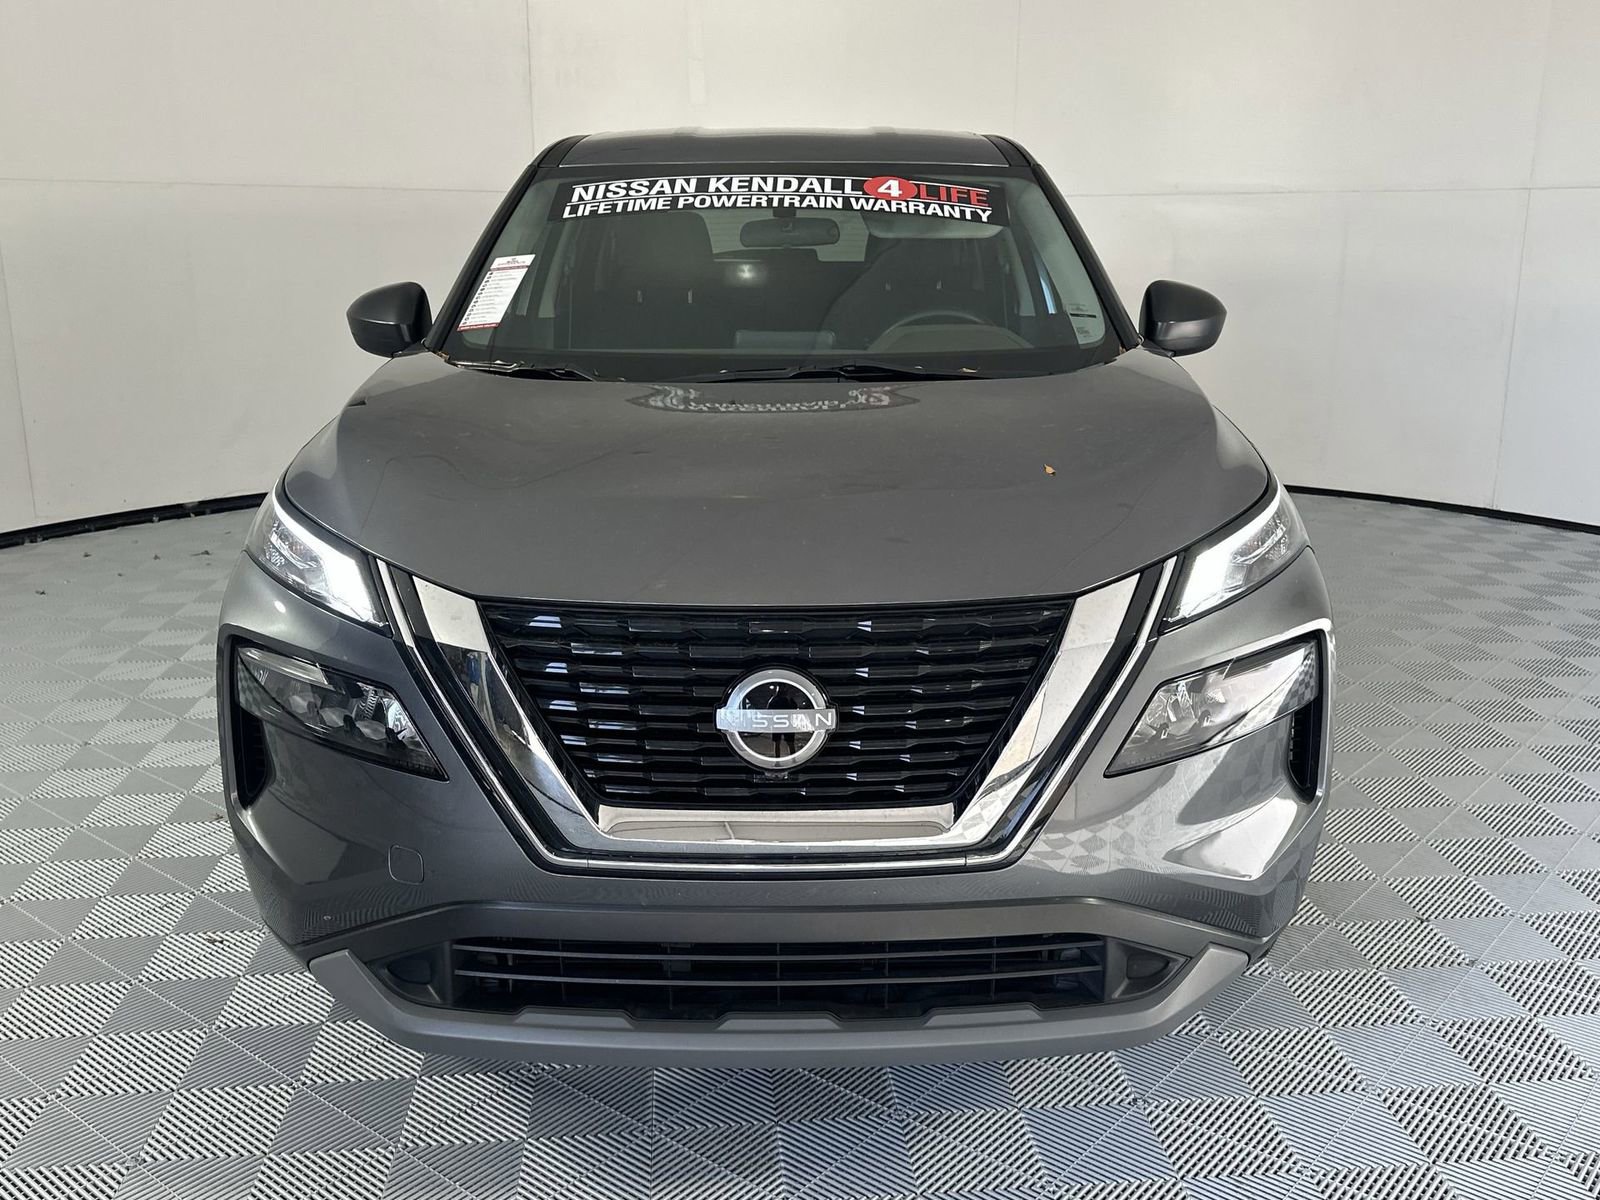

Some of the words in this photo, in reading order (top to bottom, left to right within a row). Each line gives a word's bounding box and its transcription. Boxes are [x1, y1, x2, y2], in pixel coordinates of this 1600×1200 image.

[571, 177, 697, 203] NISSAN
[707, 176, 863, 194] KENDALL
[877, 179, 903, 198] 4
[919, 184, 989, 207] LIFE
[562, 196, 673, 219] LIFETIME
[677, 194, 843, 210] POWERTRAIN
[849, 197, 993, 223] WARRANTY
[719, 711, 833, 730] NISSAN
